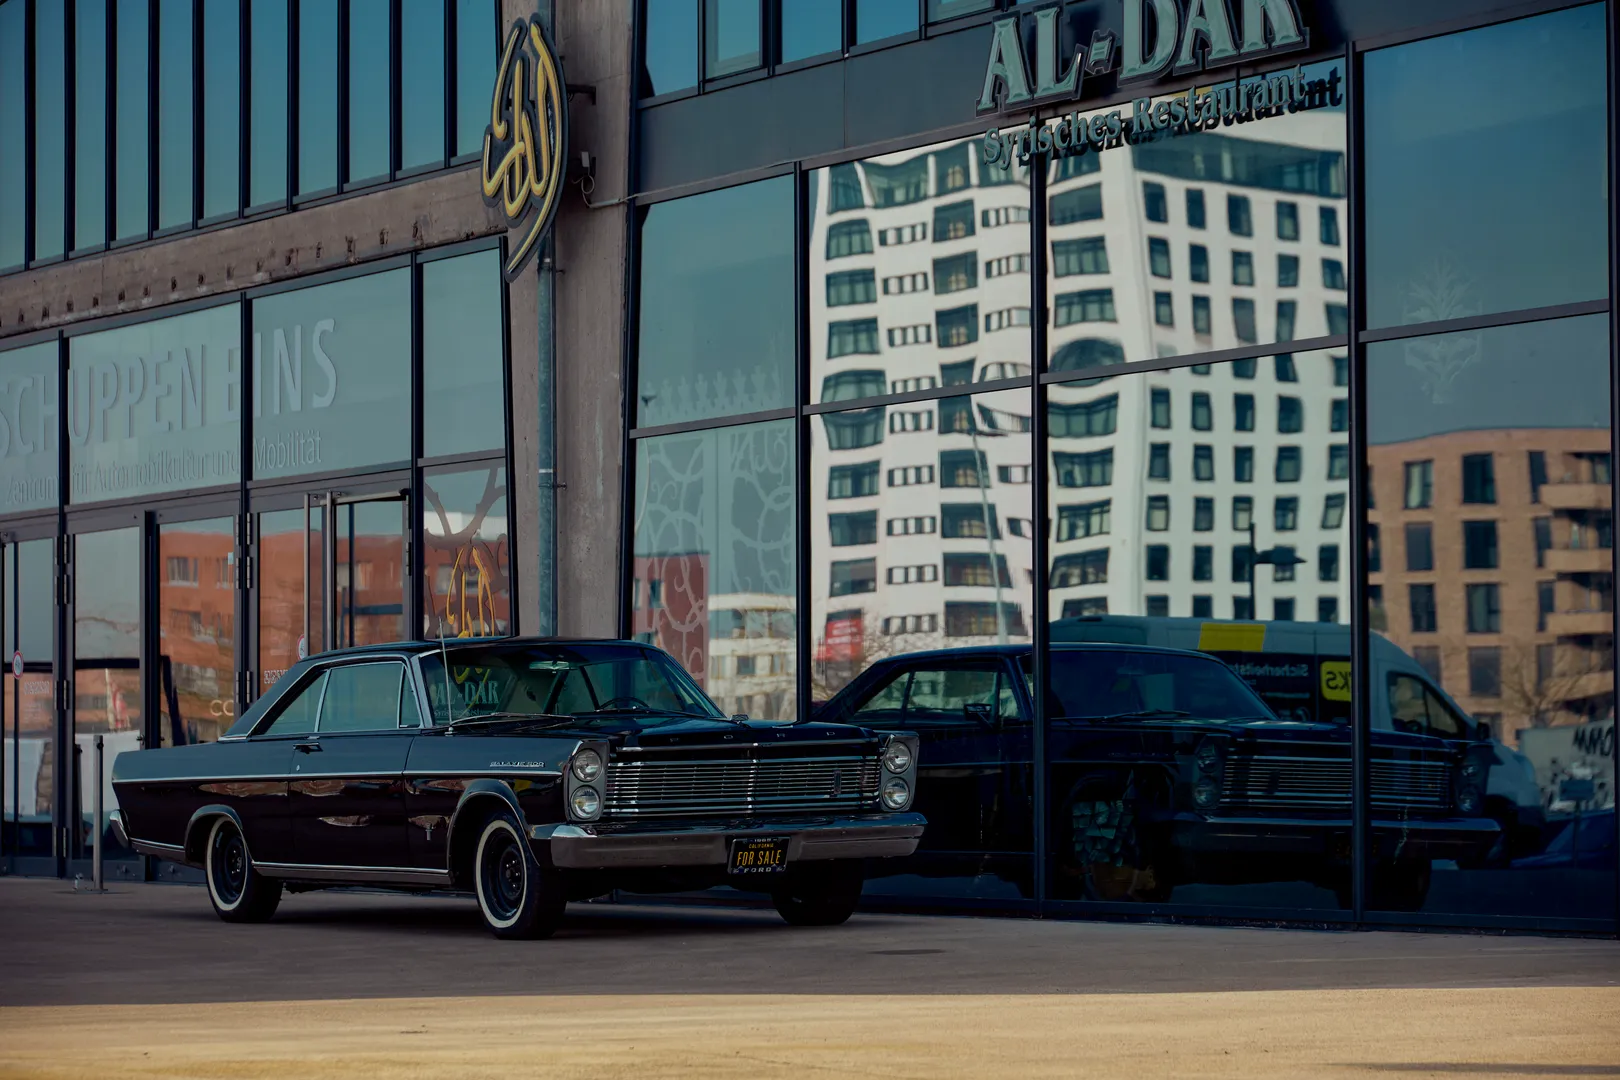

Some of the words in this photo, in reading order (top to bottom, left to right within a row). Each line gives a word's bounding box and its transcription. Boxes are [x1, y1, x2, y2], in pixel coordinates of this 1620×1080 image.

[984, 109, 1122, 171] Syrisches
[1132, 64, 1306, 134] Restaurant
[221, 317, 337, 421] EINS
[72, 462, 92, 494] für
[95, 447, 211, 493] Automobilkultur
[213, 440, 241, 477] und
[253, 431, 323, 470] Mobilität
[736, 851, 755, 866] FOR
[757, 849, 782, 865] SALE
